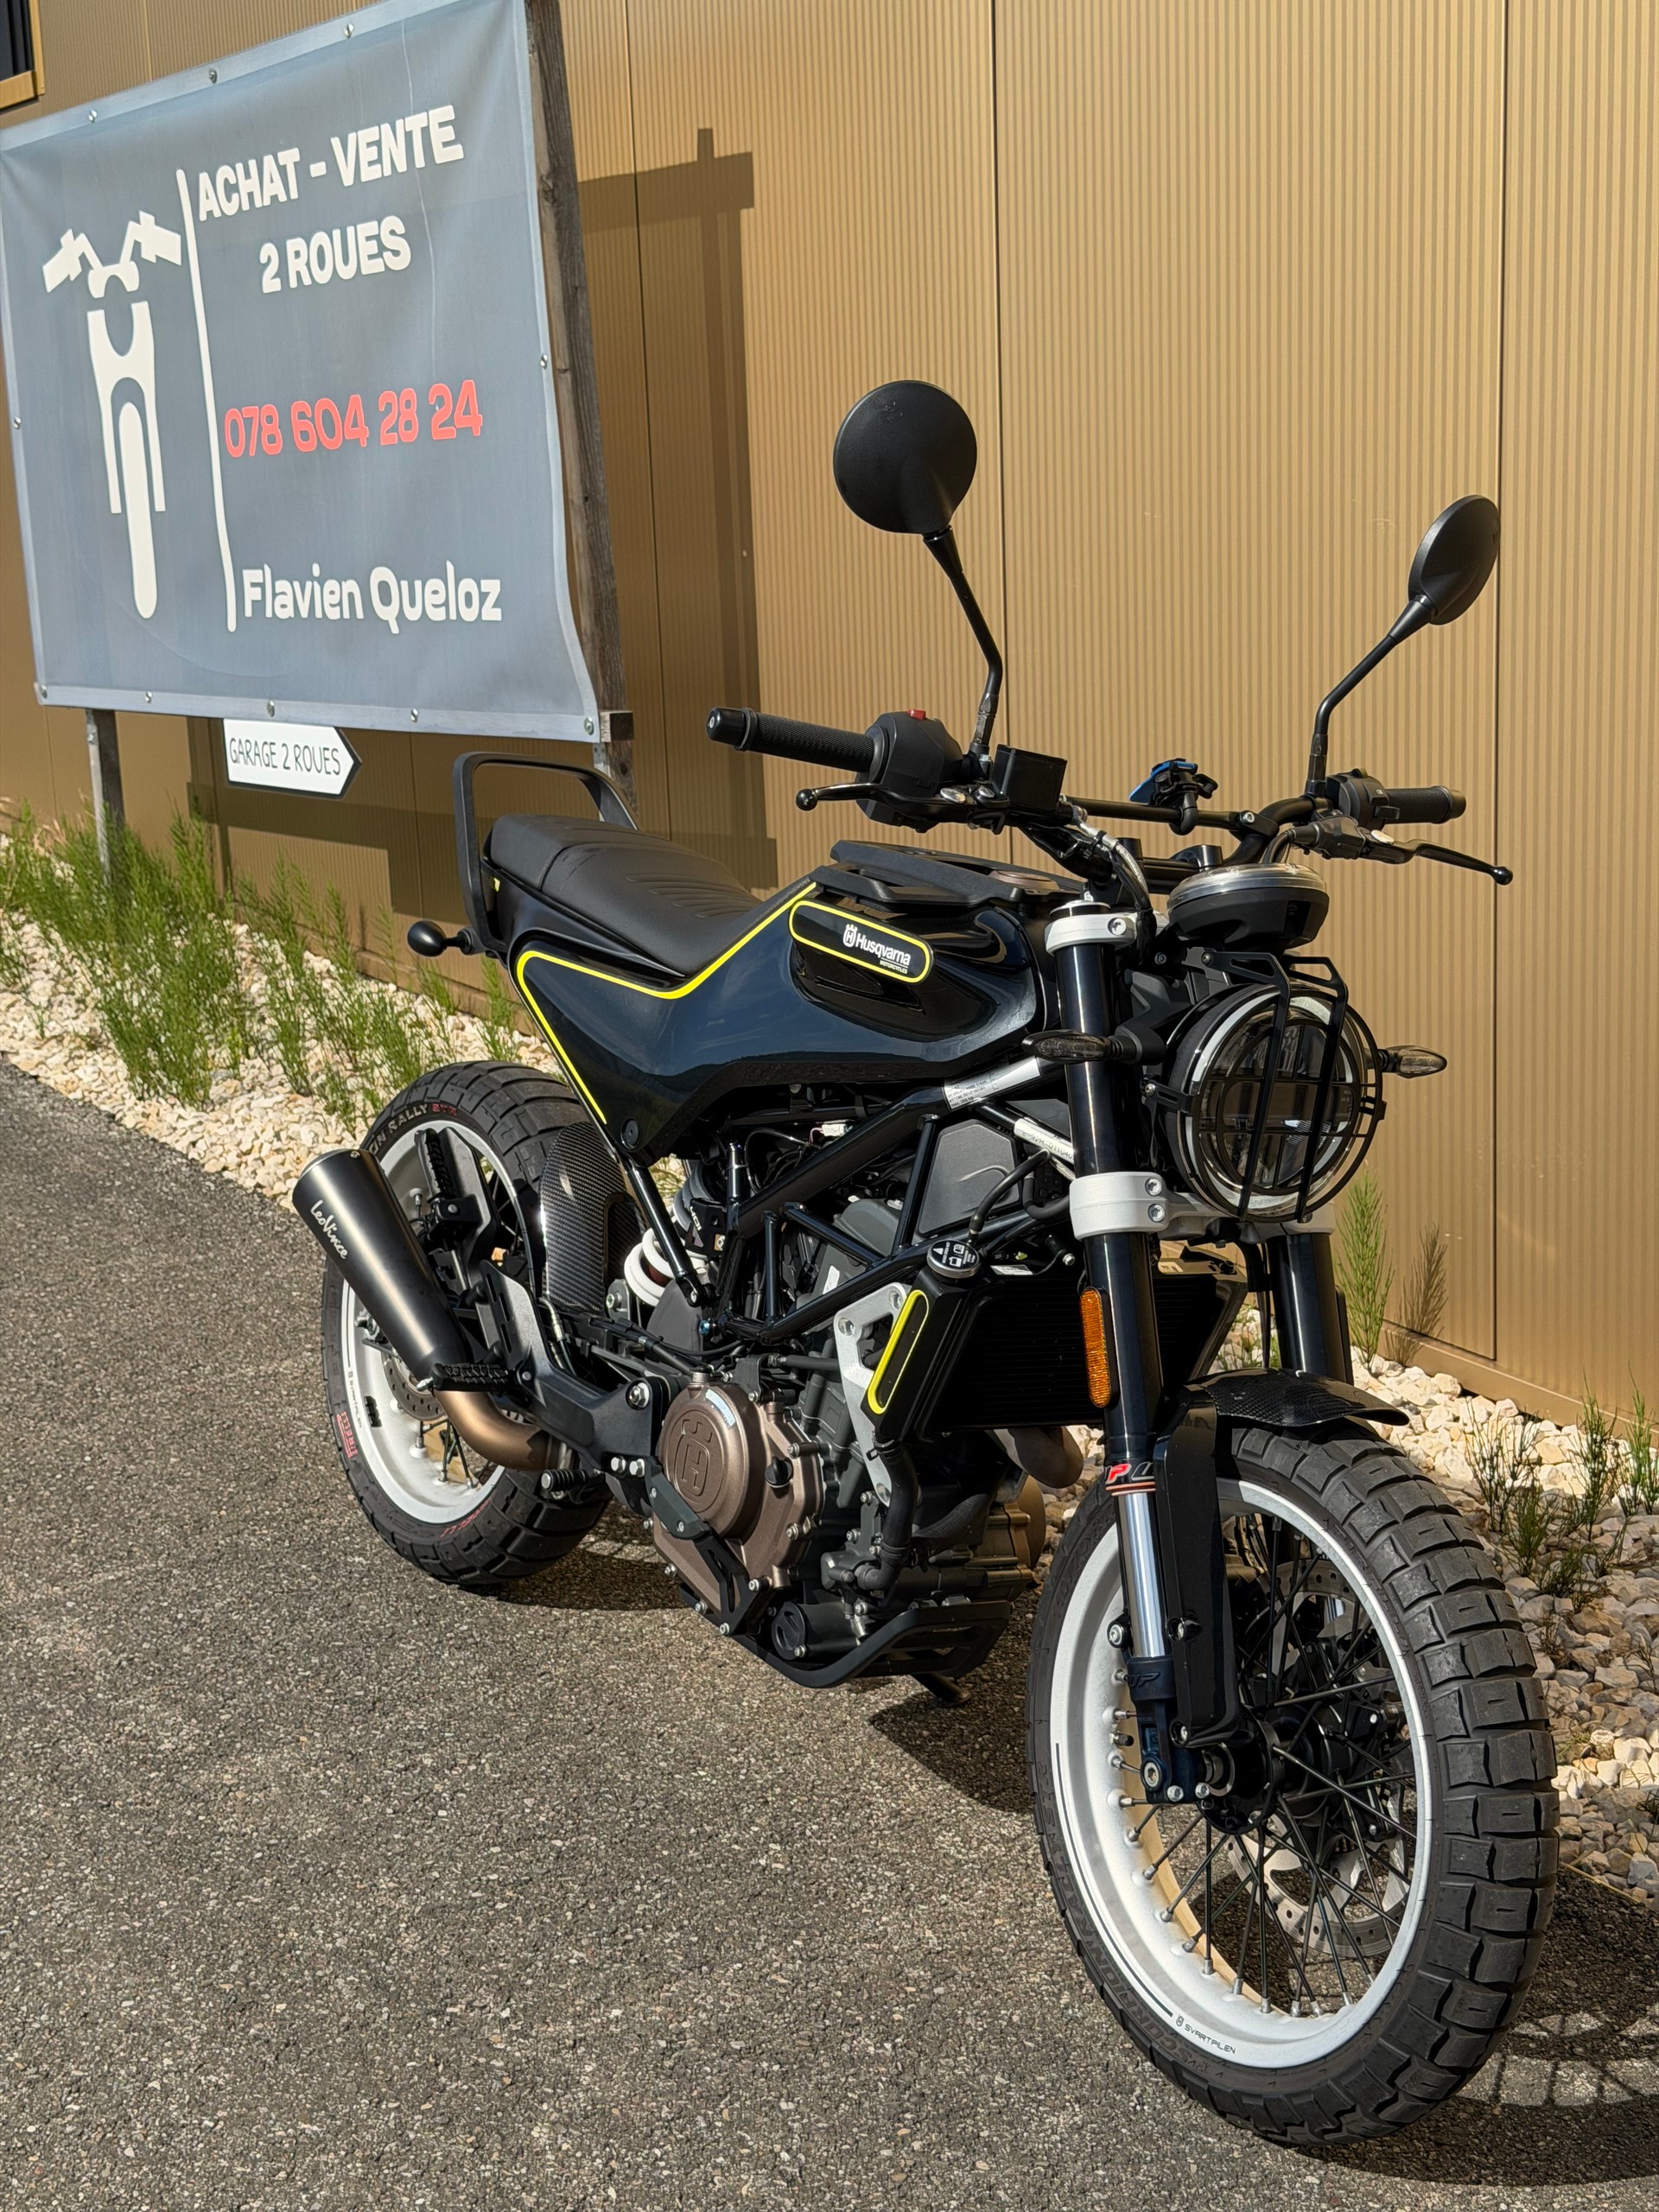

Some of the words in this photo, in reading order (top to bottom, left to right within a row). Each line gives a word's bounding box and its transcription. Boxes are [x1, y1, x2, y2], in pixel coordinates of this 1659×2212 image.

[199, 147, 302, 222] ACHAT
[309, 161, 327, 178] -
[330, 104, 465, 188] VENTE
[259, 242, 282, 294] 2
[285, 215, 411, 289] ROUES
[224, 404, 283, 458] 078
[289, 394, 369, 453] 604
[378, 388, 419, 446] 28
[428, 379, 483, 441] 24
[242, 563, 364, 620] Flavien
[369, 560, 502, 634] Queloz
[228, 736, 278, 769] GARAGE
[281, 742, 291, 771] 2
[293, 743, 341, 776] ROUES
[855, 931, 912, 967] Husqvarna
[388, 1103, 429, 1134] RALLY
[310, 1199, 348, 1260] LeoVince
[335, 1410, 358, 1459] PIRELLI
[1183, 2023, 1236, 2055] SVARTPILEN
